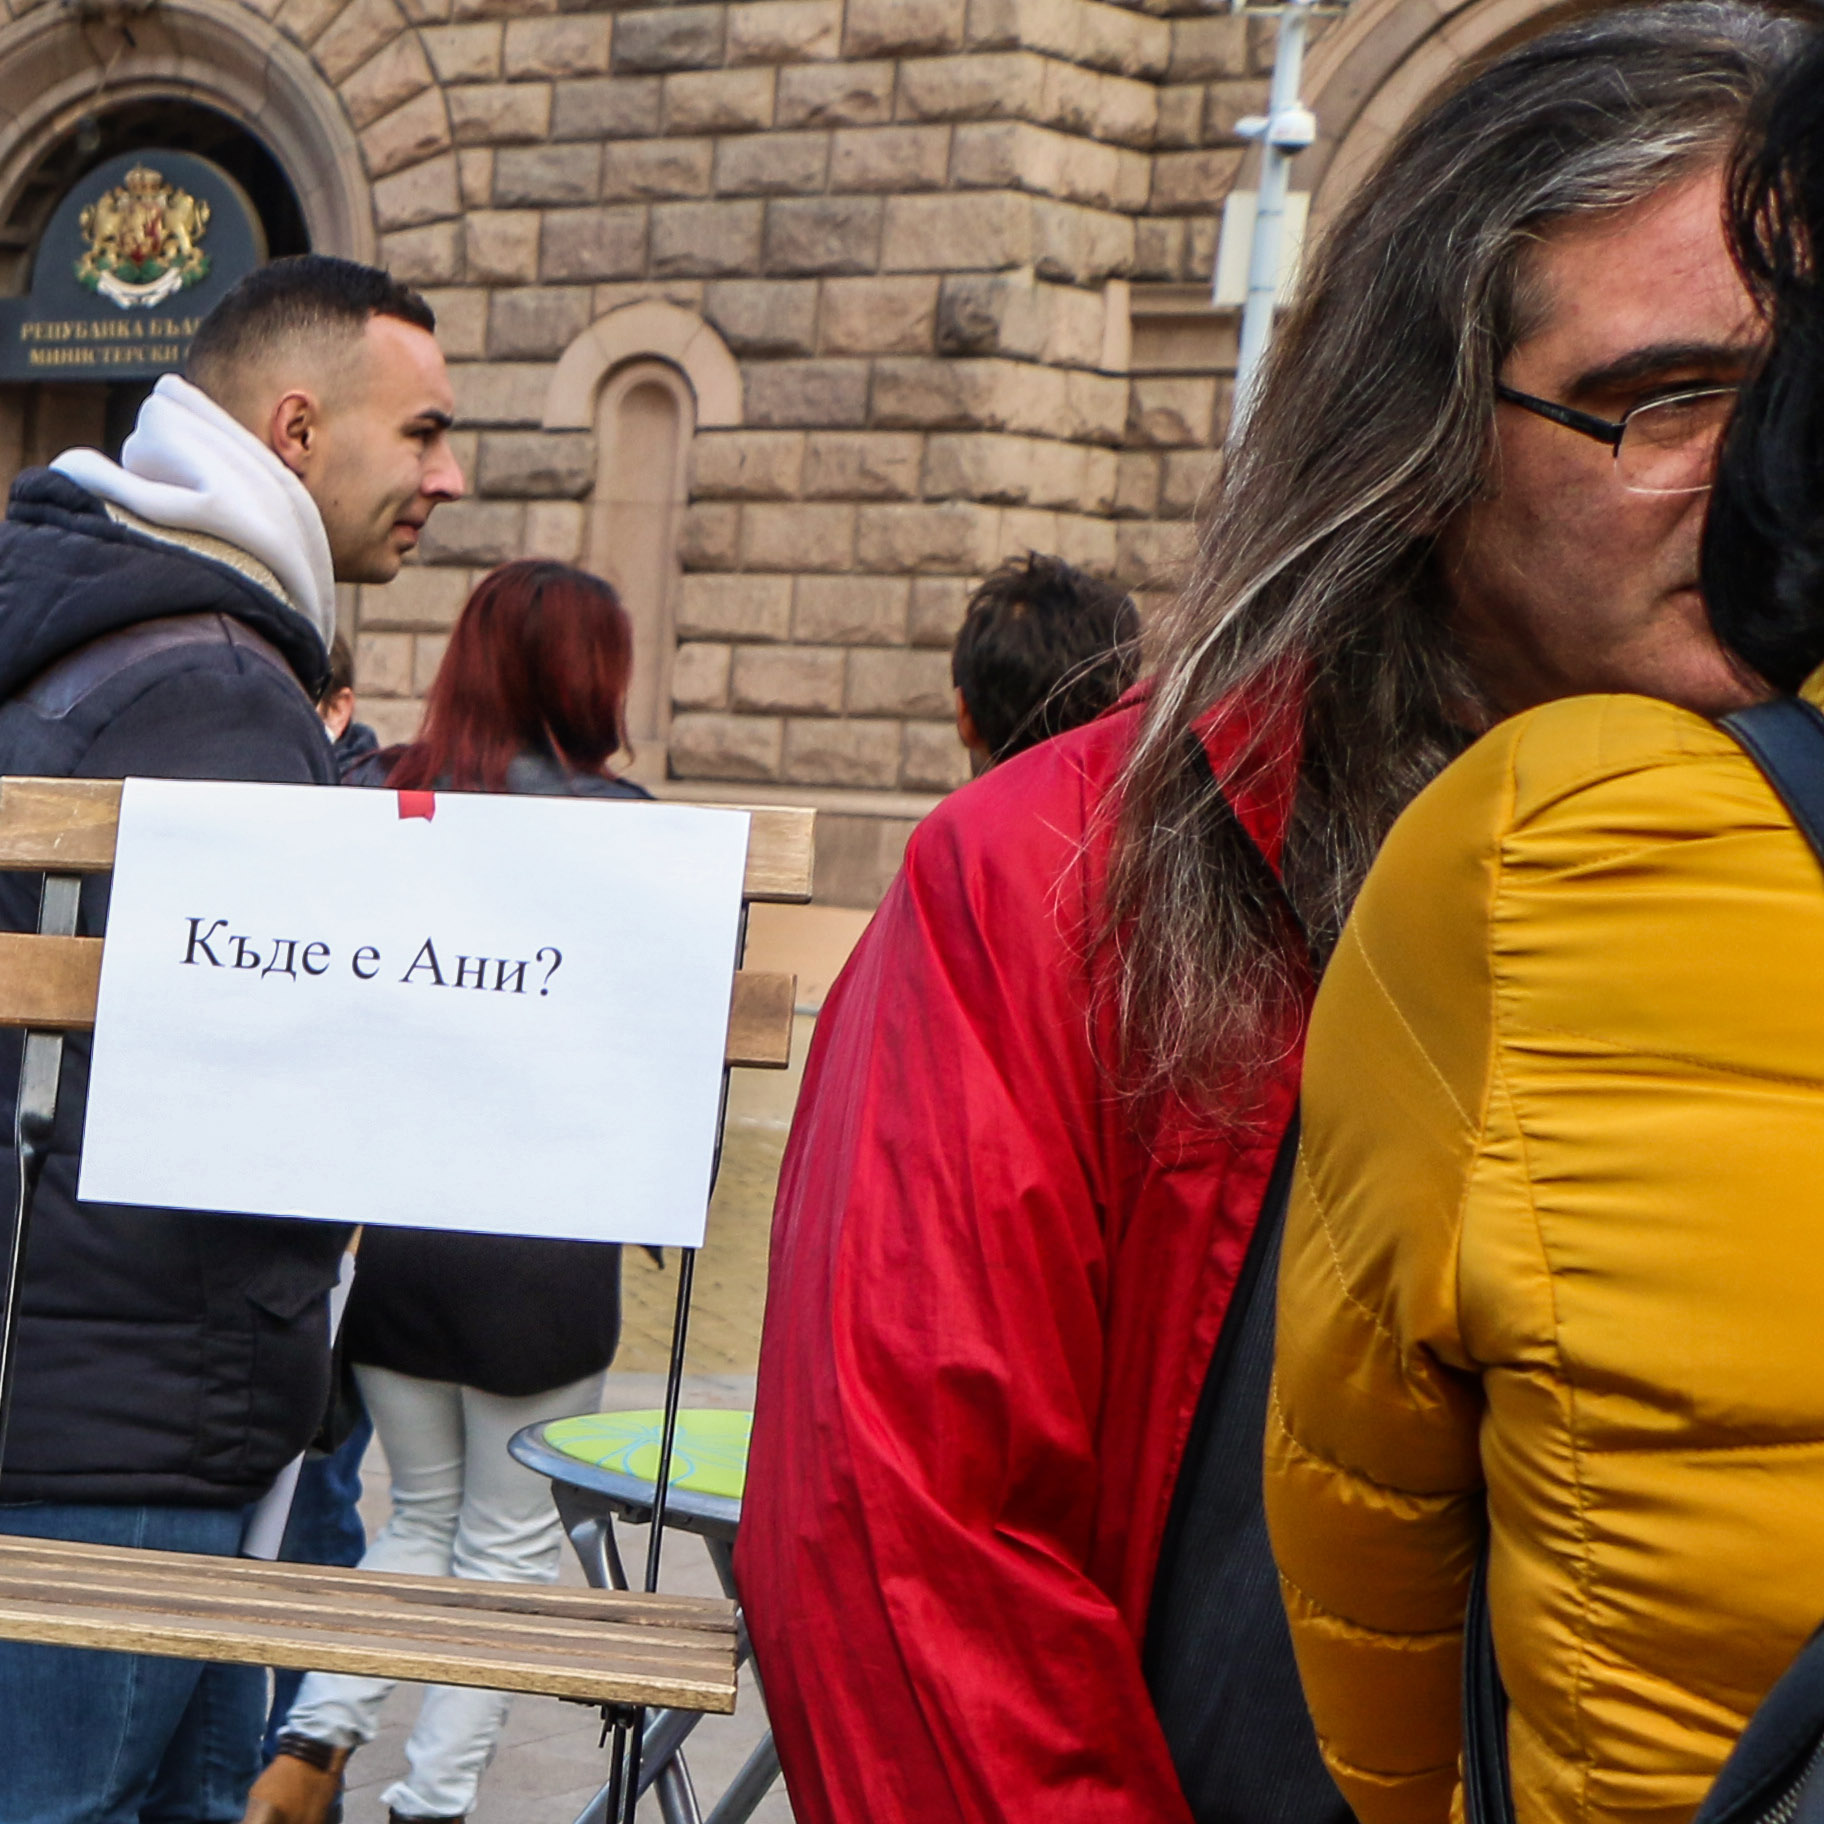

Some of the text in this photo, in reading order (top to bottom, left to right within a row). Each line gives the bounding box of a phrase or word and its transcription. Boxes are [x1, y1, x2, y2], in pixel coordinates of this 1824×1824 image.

[20, 317, 203, 341] РЕПУБЛИКА БЪЛГ
[28, 343, 180, 367] МИНИСТЕРСКИ
[179, 917, 563, 997] Къде е Ани?
